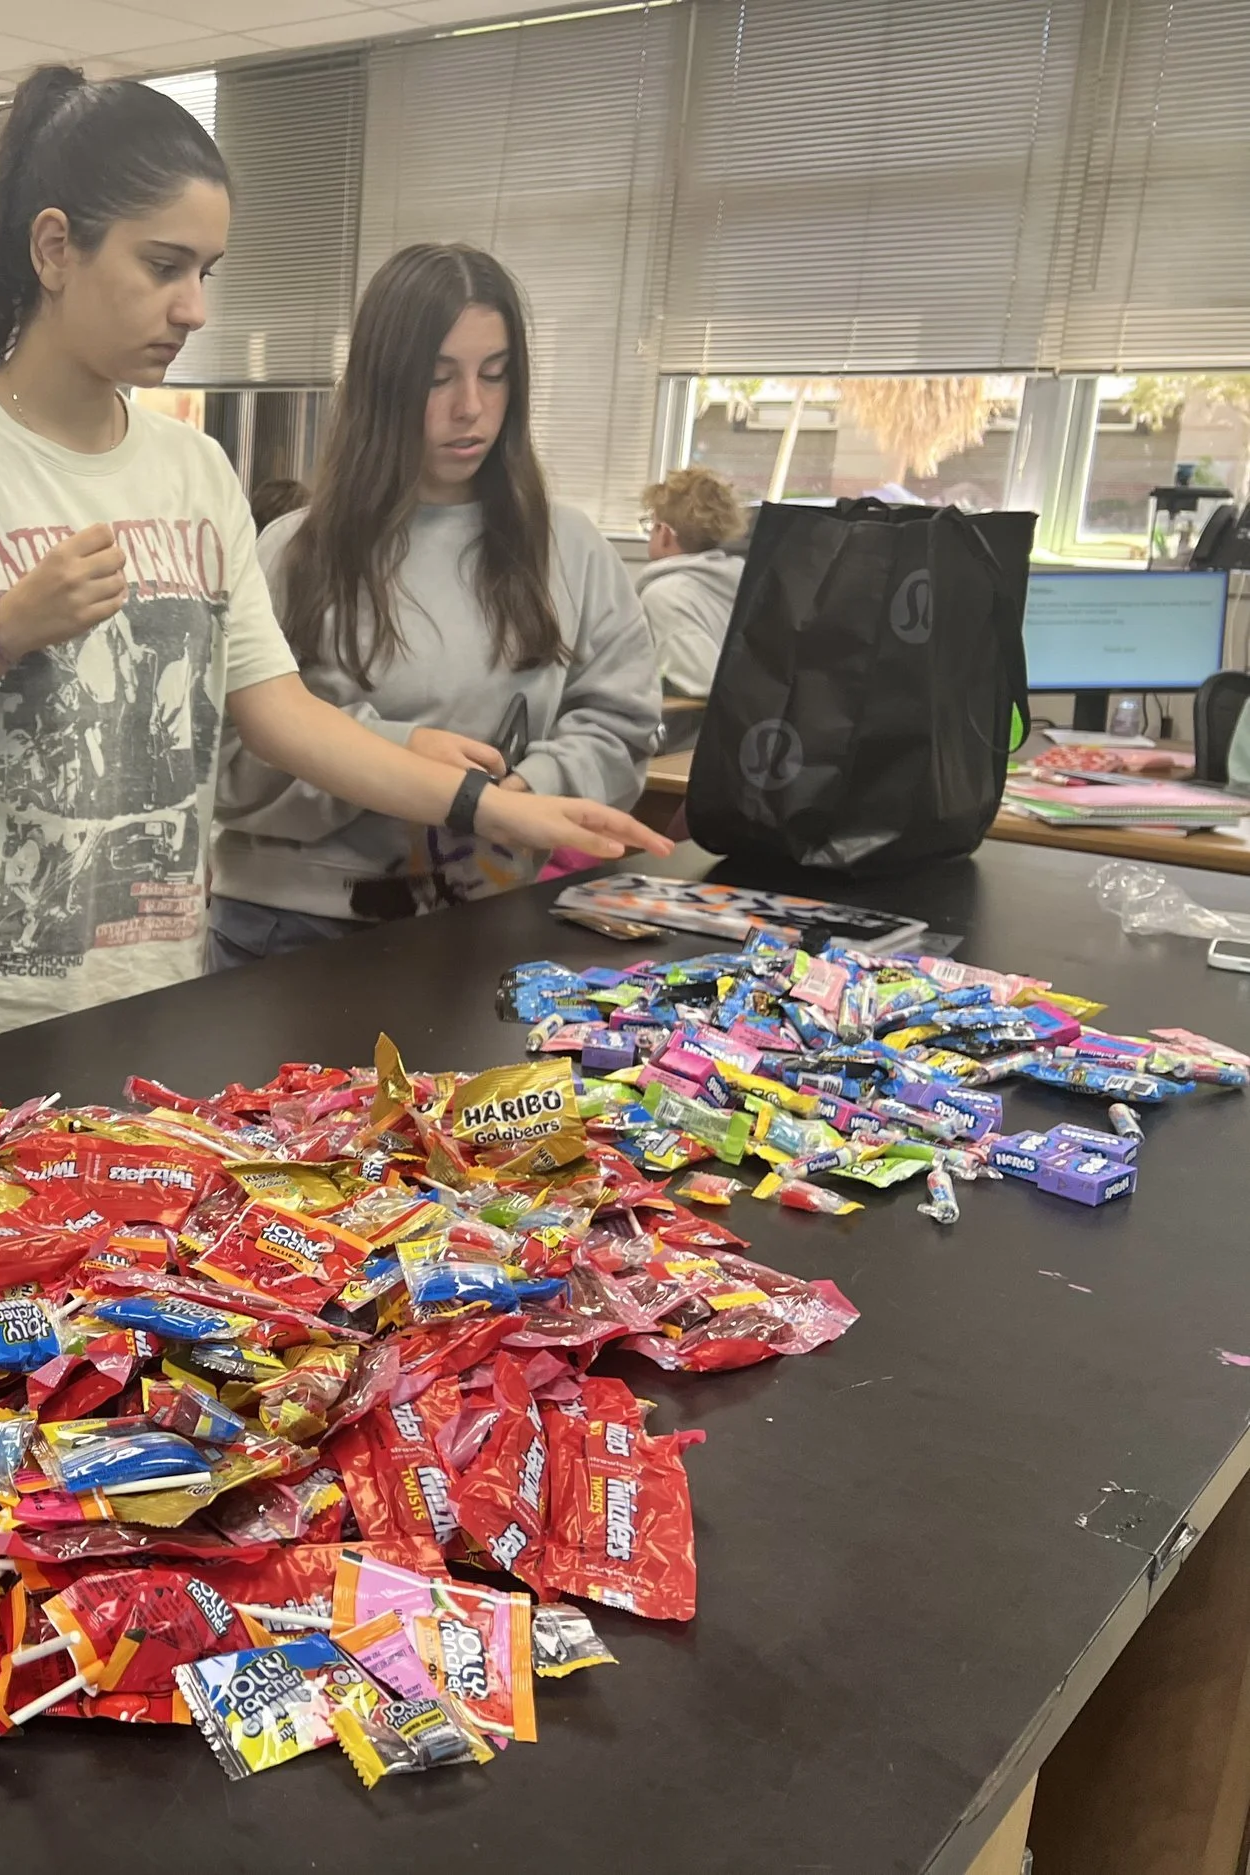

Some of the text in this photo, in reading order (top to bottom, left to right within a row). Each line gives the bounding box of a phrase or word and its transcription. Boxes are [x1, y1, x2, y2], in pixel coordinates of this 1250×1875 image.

[463, 1090, 562, 1128] HARIBO
[474, 1119, 561, 1145] Goldbears
[108, 1166, 197, 1192] Twizzlers
[995, 1152, 1036, 1172] Nerds
[400, 1469, 428, 1522] TWISTS
[589, 1476, 604, 1514] TWISTS
[605, 1477, 638, 1561] Twizzlers
[186, 1583, 228, 1634] rancher
[225, 1652, 286, 1711] JOLLY
[439, 1620, 465, 1700] rancher
[453, 1618, 489, 1700] JOLLY
[237, 1669, 302, 1719] rancher
[394, 1700, 439, 1729] rancher
